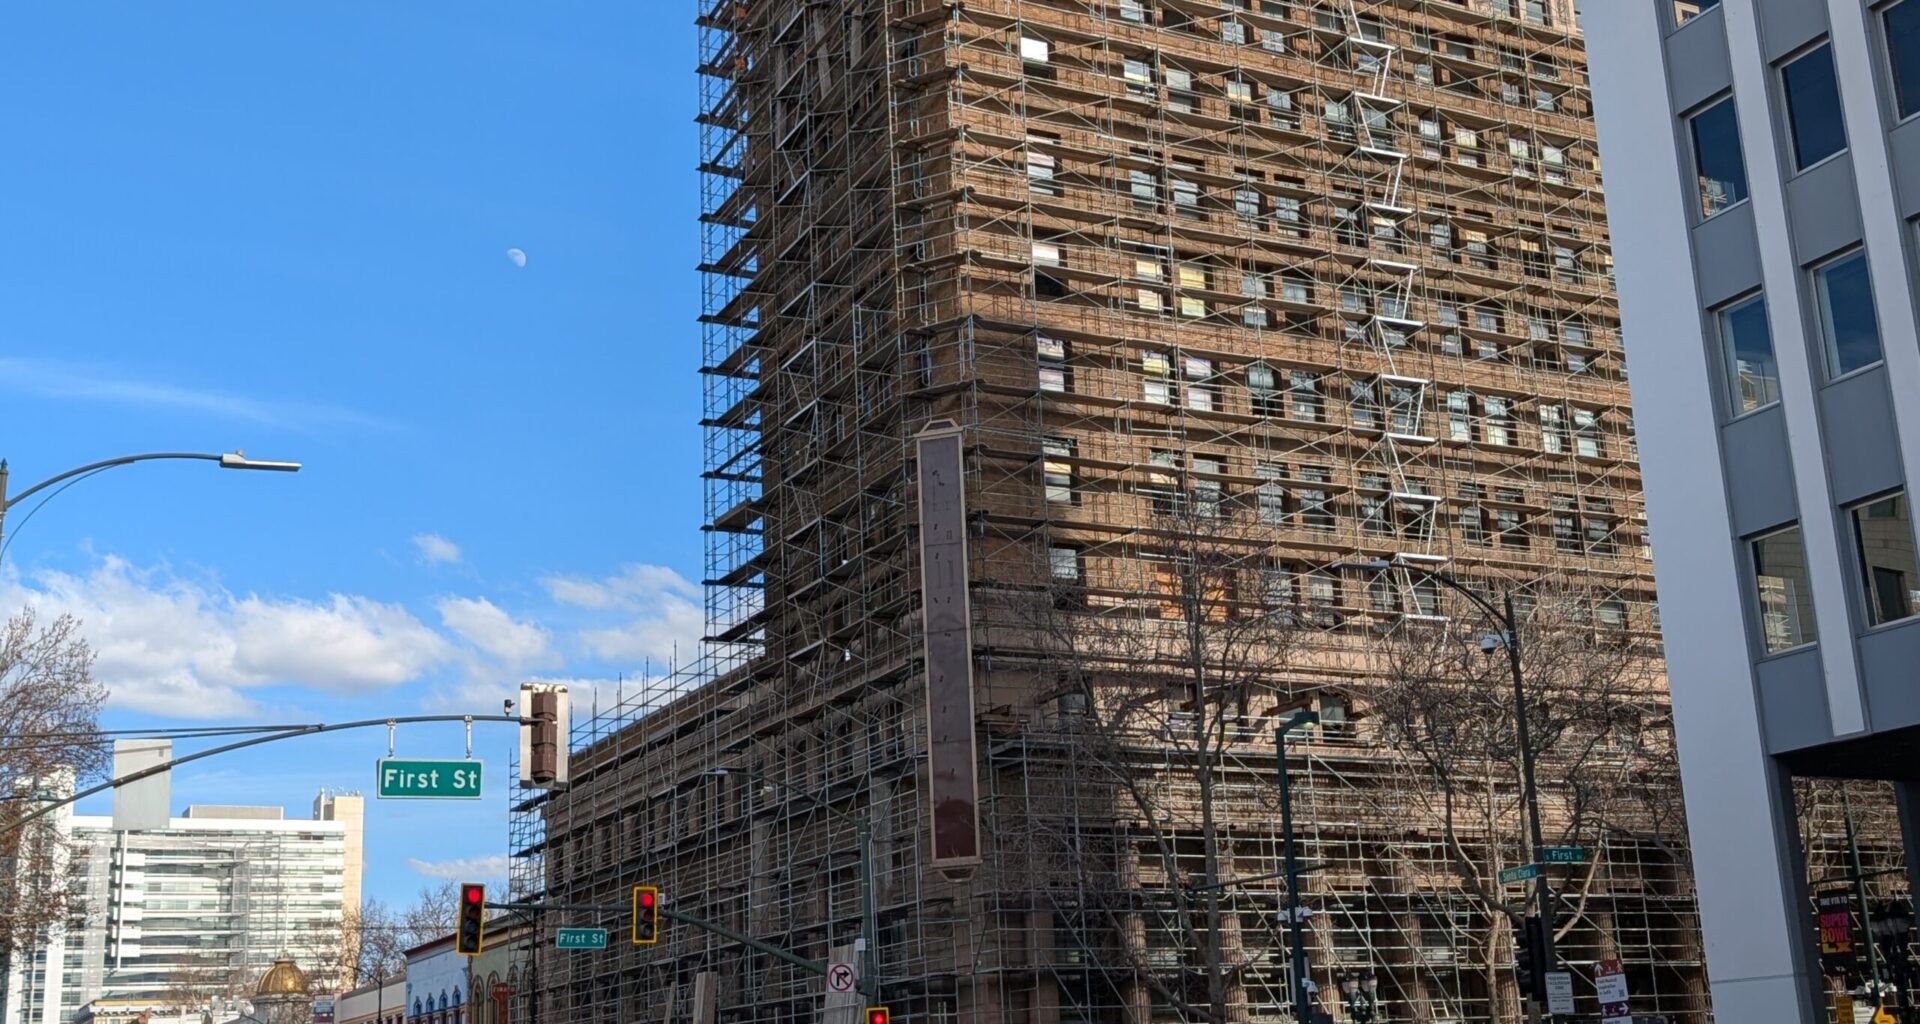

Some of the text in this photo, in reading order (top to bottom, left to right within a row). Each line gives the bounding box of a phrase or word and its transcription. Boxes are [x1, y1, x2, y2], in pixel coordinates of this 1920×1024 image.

[384, 768, 478, 790] First St
[1551, 849, 1573, 861] First
[1820, 912, 1849, 928] SUPER
[559, 932, 604, 944] First St
[1821, 927, 1852, 943] BOWL
[1822, 942, 1854, 954] LX
